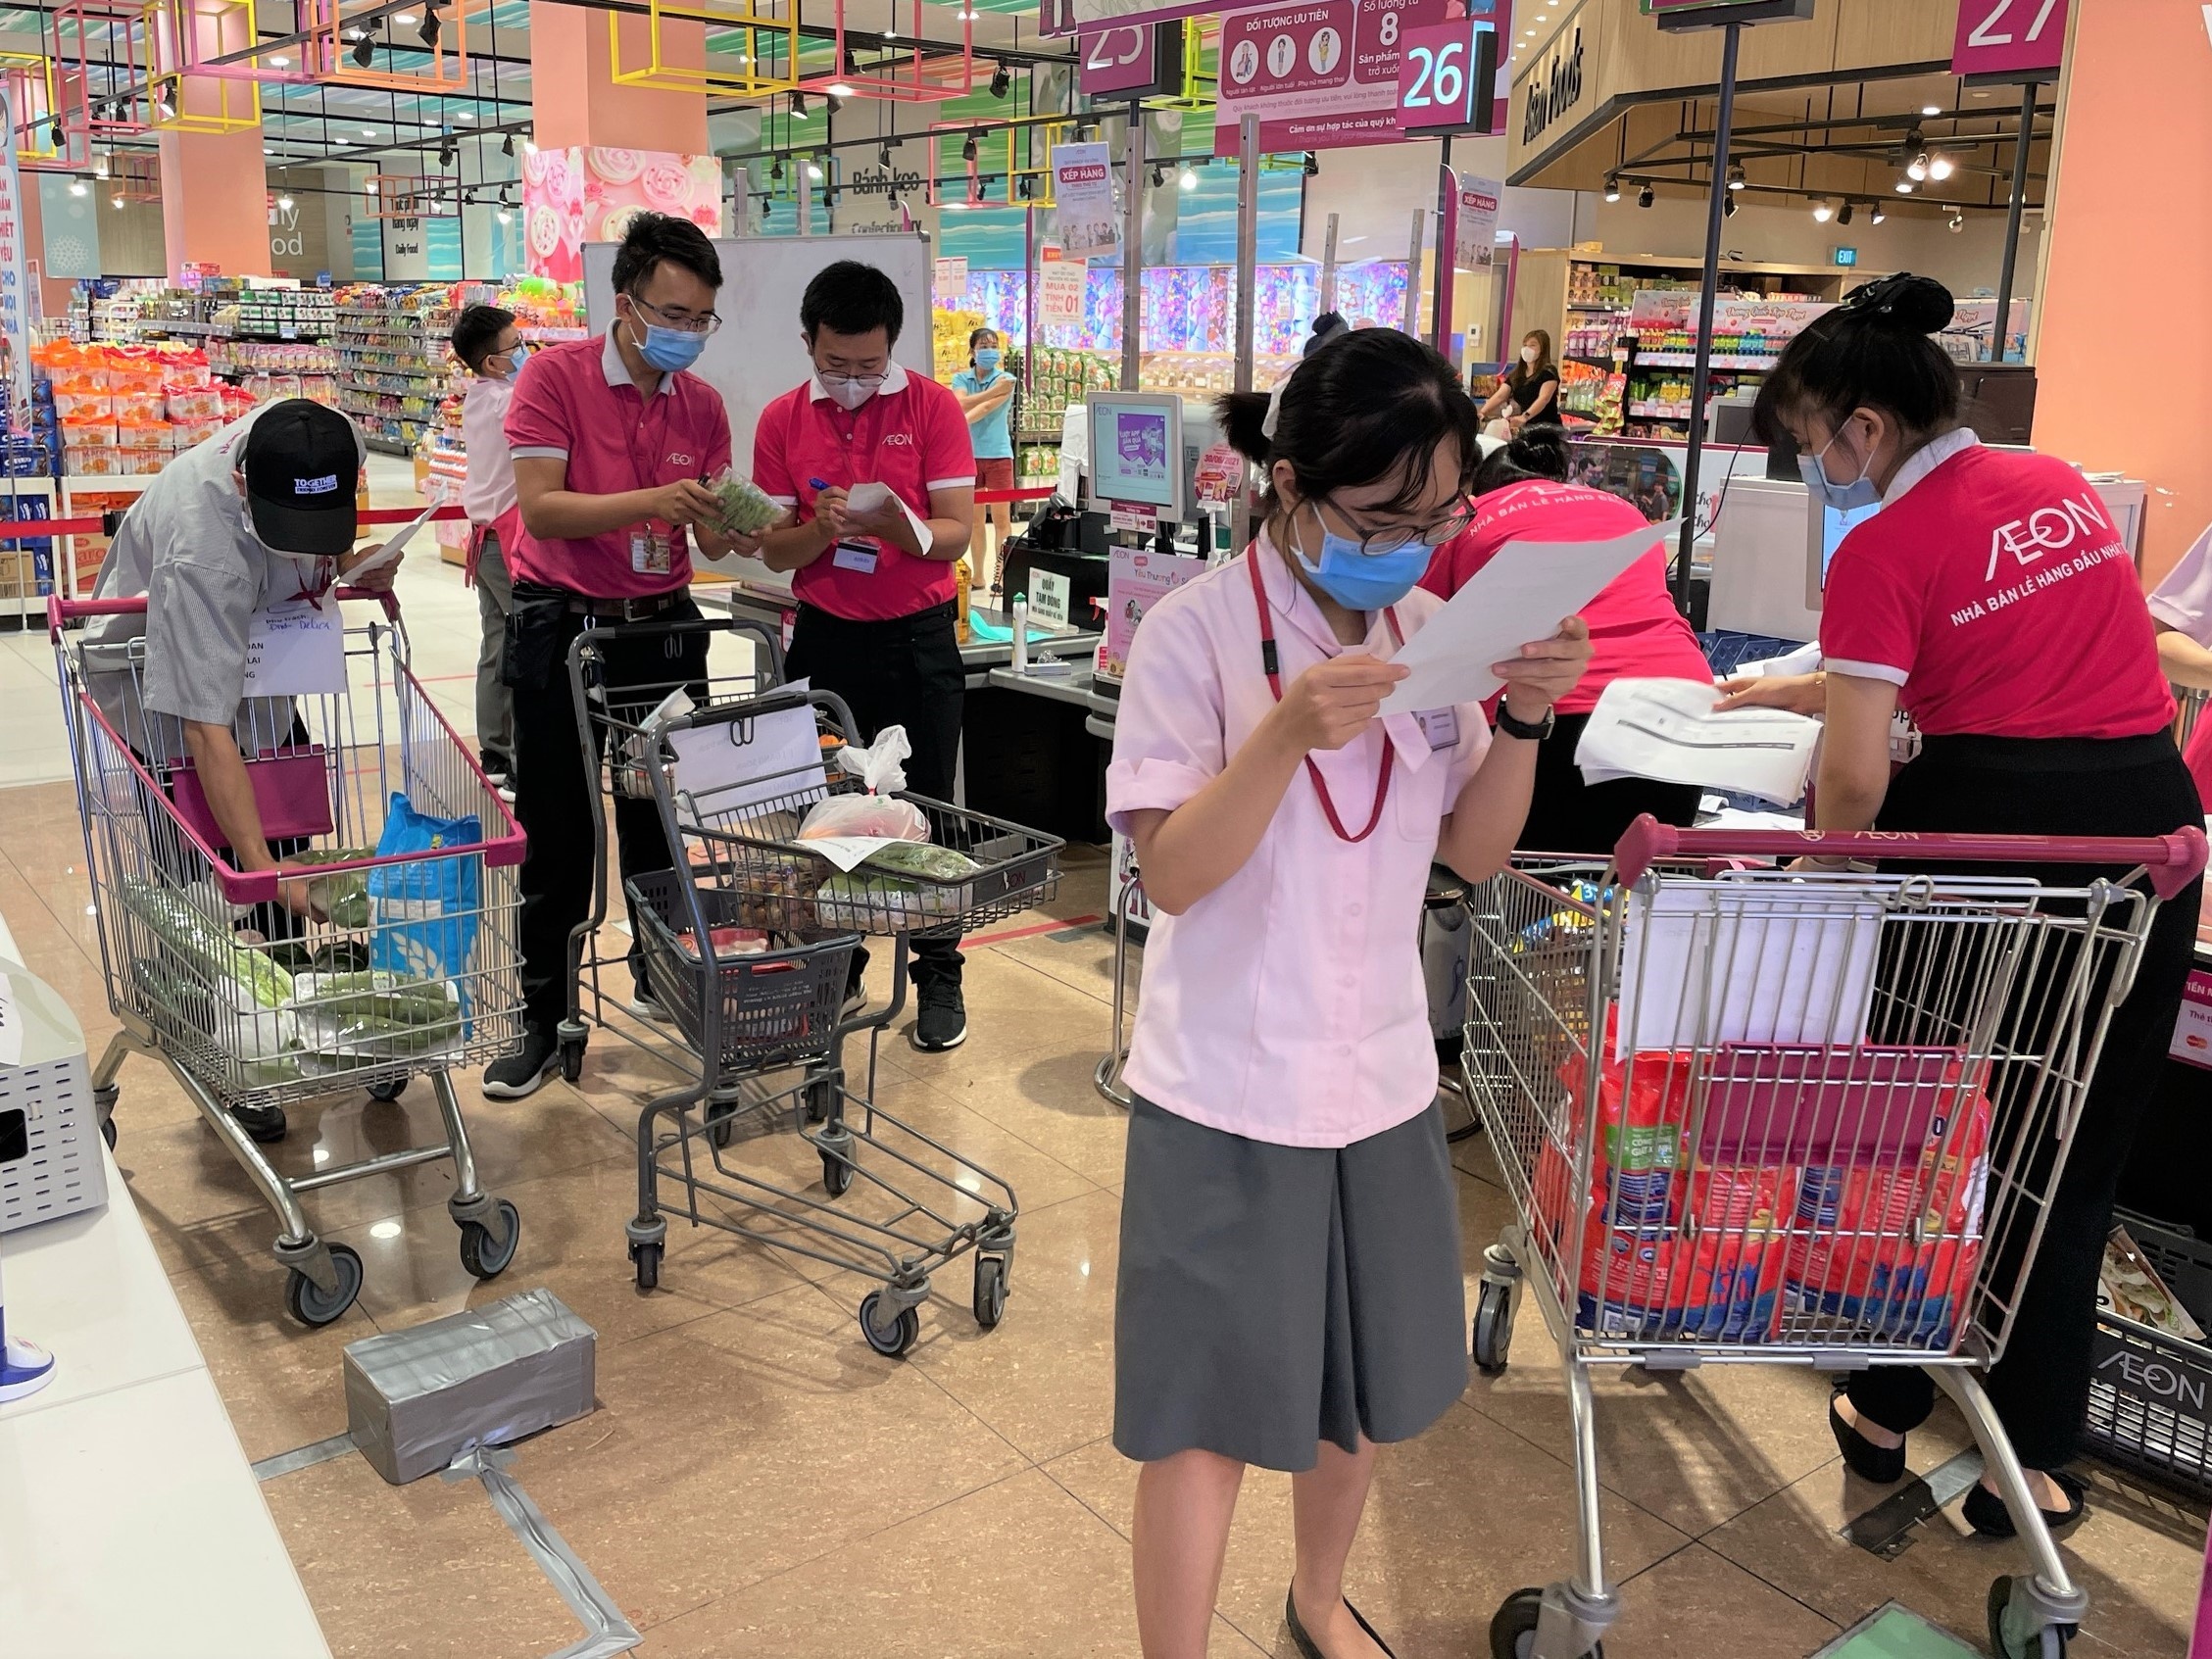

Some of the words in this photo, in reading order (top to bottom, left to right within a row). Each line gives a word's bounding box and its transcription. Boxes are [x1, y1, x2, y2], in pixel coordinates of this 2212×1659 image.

[1309, 9, 1329, 23] TIÊN
[1379, 12, 1399, 46] 8
[1403, 42, 1463, 108] 26
[1522, 81, 1548, 146] Asian
[1548, 27, 1584, 123] Foods
[853, 169, 888, 195] Bánh
[1061, 168, 1079, 180] XẾP
[1080, 167, 1105, 178] HÀNG
[1838, 250, 1853, 264] EXIT
[1046, 282, 1066, 291] MUA
[1068, 283, 1078, 292] 02
[1065, 295, 1079, 313] 01
[1469, 514, 1495, 537] NHÀ
[1498, 502, 1528, 517] BÁN
[1554, 493, 1596, 504] HÀNG
[1950, 601, 1986, 627] NHÀ
[1987, 588, 2019, 611] BÁN
[2019, 574, 2037, 598] LẺ
[2036, 562, 2074, 588] HÀNG
[2073, 549, 2101, 572] ĐẦU
